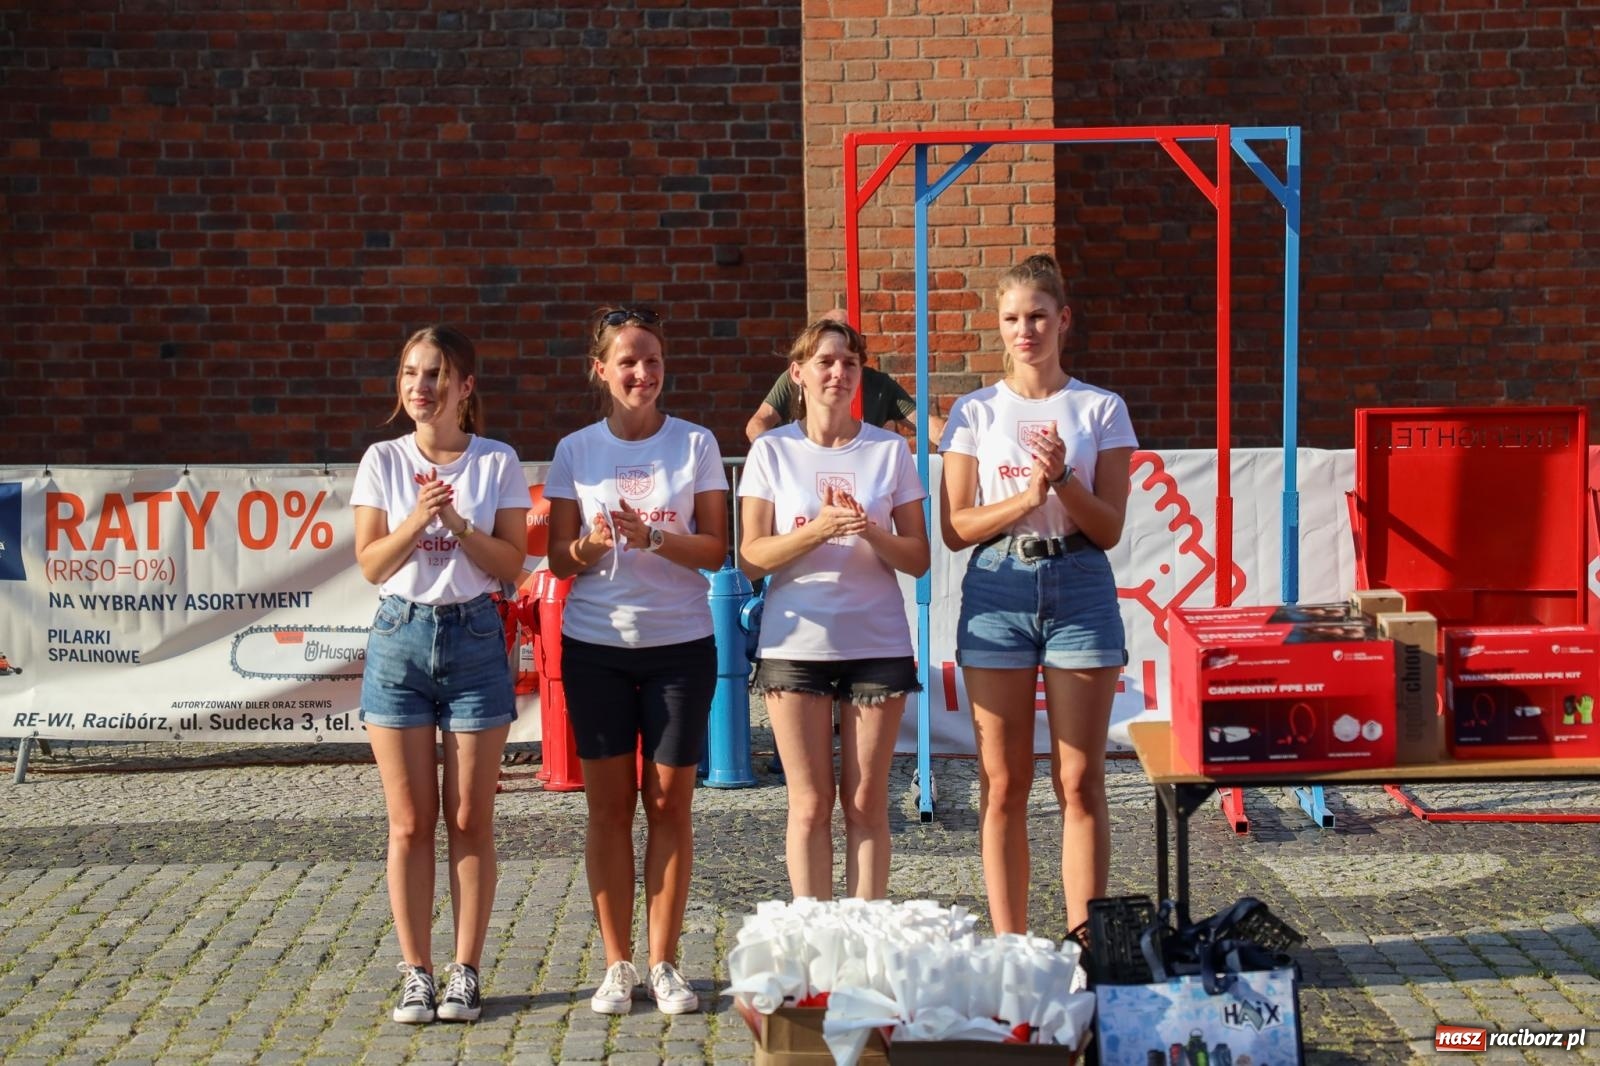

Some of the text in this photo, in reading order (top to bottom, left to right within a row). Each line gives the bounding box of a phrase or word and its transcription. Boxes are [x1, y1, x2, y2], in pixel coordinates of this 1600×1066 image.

[46, 490, 333, 551] RATY 0%
[45, 556, 176, 585] (RRSO=0%)
[49, 591, 313, 611] NA WYBRANY ASORTYMENT
[48, 629, 111, 645] PILARKI
[49, 648, 141, 664] SPALINOWE
[318, 644, 366, 662] Husqva
[1565, 671, 1582, 679] KIT
[1207, 683, 1325, 696] CARPENTRY PPE KIT
[171, 700, 332, 710] AUTORYZOWANY DILER ORAZ SERWIS
[13, 712, 76, 730] RE-WI,
[82, 712, 173, 732] Racibórz,
[180, 713, 202, 731] ul.
[210, 713, 294, 731] Sudecka
[301, 713, 319, 734] 3,
[325, 713, 354, 731] tel.
